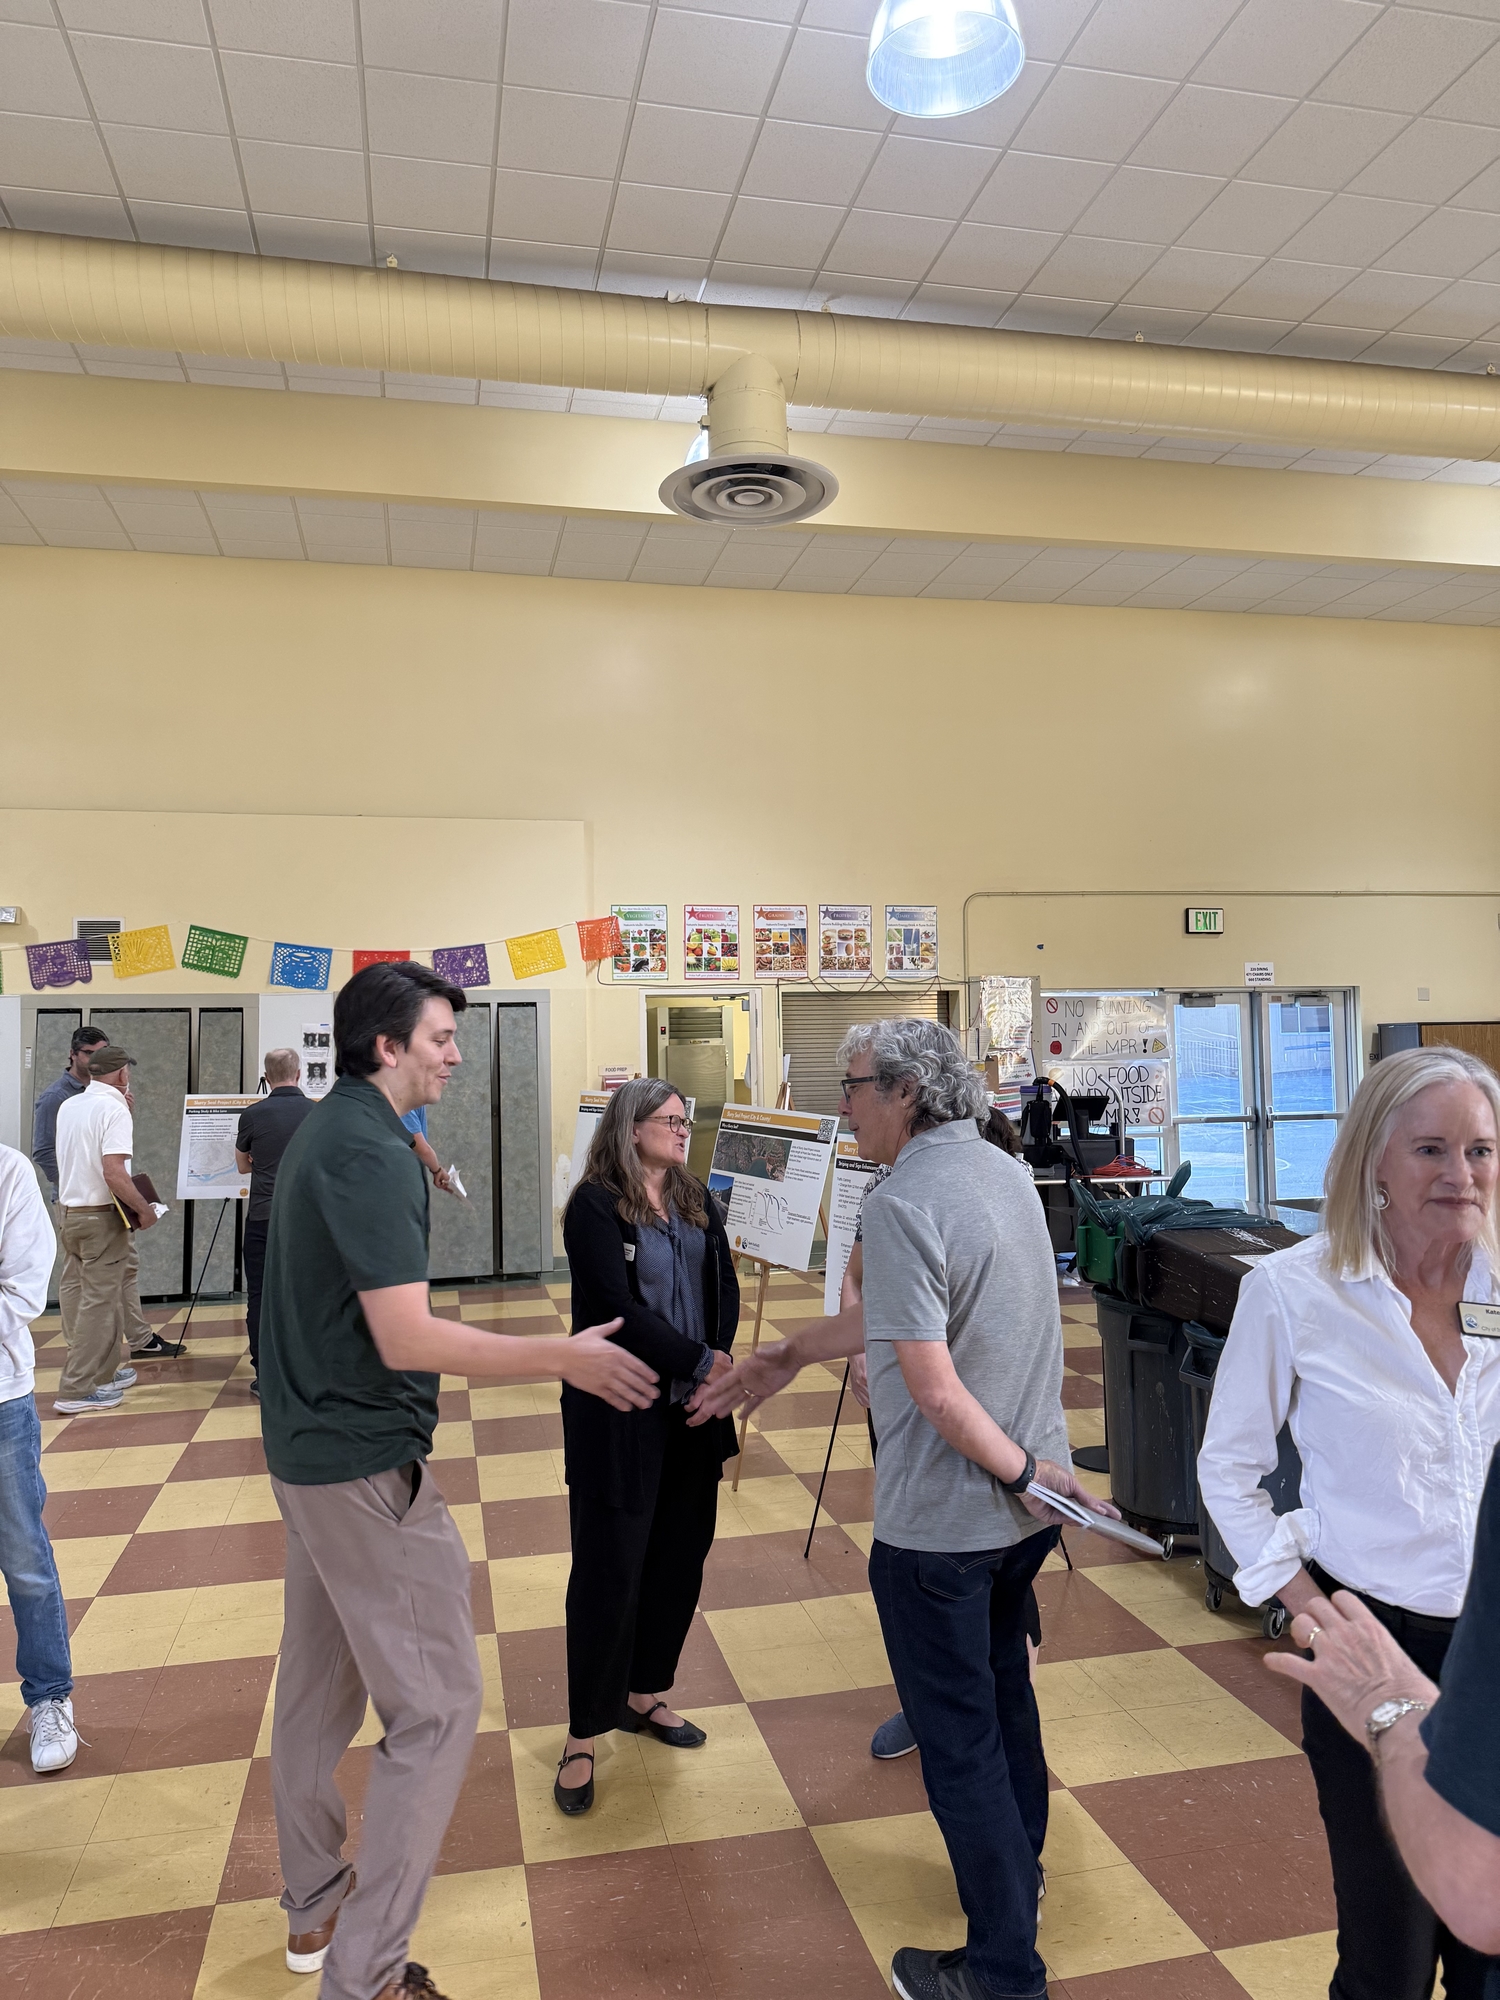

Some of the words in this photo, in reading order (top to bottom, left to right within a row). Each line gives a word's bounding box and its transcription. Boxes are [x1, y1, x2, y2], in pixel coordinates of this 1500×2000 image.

[1195, 911, 1218, 930] EXIT
[1064, 1000, 1085, 1018] NO
[1095, 999, 1152, 1016] RUNNING
[1051, 1022, 1067, 1038] IN
[1076, 1021, 1100, 1037] AND
[1106, 1020, 1130, 1036] OUT
[1138, 1020, 1155, 1034] OF
[1071, 1039, 1099, 1055] THE
[1072, 1066, 1098, 1087] NO
[1108, 1065, 1150, 1085] FOOD
[740, 1112, 750, 1120] Project
[844, 1144, 856, 1154] Slurry
[838, 1160, 849, 1168] Striping
